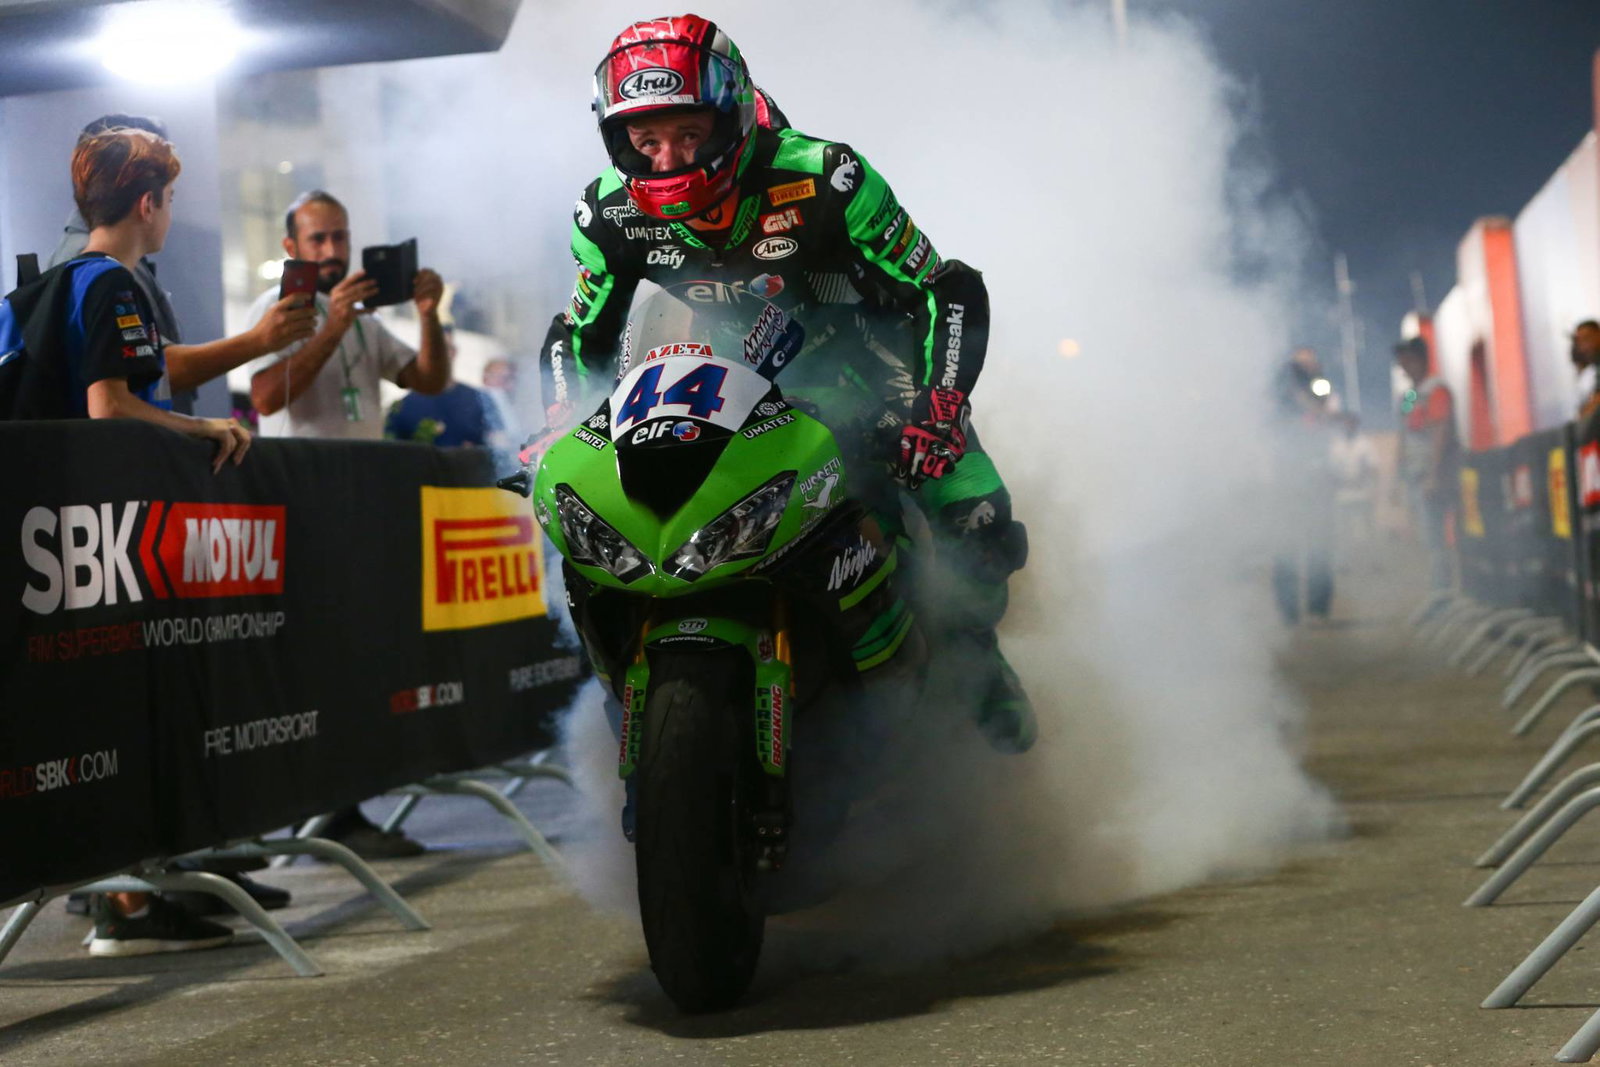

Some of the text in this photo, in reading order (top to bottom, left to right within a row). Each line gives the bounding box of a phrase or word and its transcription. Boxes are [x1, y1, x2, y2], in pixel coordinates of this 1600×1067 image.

[632, 73, 674, 93] Arai
[763, 209, 799, 233] GIVI
[646, 249, 686, 269] Dafy
[760, 239, 792, 255] Arai
[686, 280, 744, 304] elf
[645, 344, 713, 361] AZETA
[937, 303, 965, 391] awasaki
[616, 362, 728, 428] 44
[575, 429, 606, 450] UMATEX
[632, 420, 674, 445] elf
[743, 414, 795, 440] UMATEX
[21, 500, 279, 615] SBK MOTUL
[434, 515, 540, 605] PIRELLI
[827, 535, 877, 592] Ninja
[142, 617, 203, 647] WORLD
[235, 710, 319, 755] MOTORSPORT
[757, 687, 771, 764] PIRELLI
[771, 684, 783, 767] BRAKING
